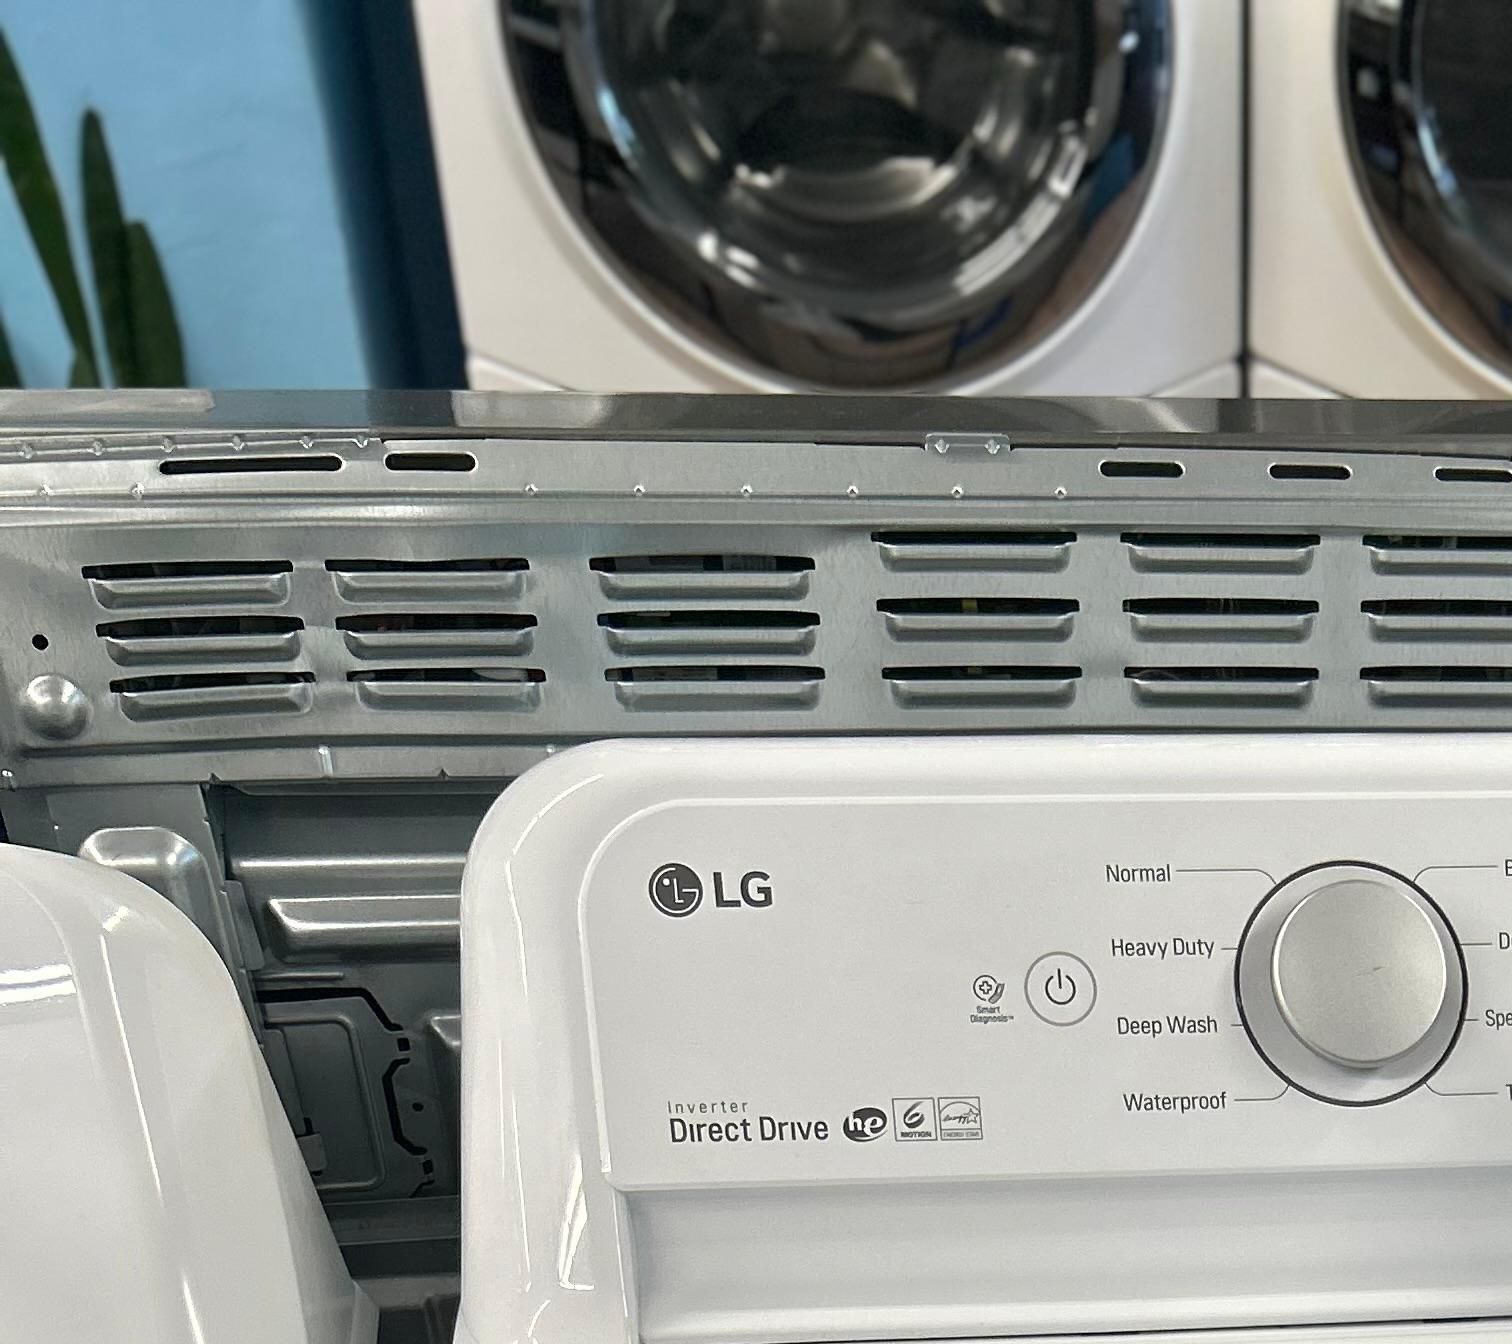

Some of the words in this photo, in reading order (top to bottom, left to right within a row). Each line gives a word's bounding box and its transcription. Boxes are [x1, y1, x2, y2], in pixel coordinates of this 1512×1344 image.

[1106, 864, 1171, 884] Normal
[713, 871, 773, 908] LG
[1111, 938, 1168, 958] Heavy
[1173, 937, 1215, 959] Duty
[1117, 1016, 1163, 1038] Deep
[1167, 1015, 1218, 1035] Wash
[667, 1101, 749, 1115] Inverter
[1123, 1091, 1227, 1113] Waterproof
[670, 1116, 753, 1144] Direct
[759, 1114, 829, 1143] Drive
